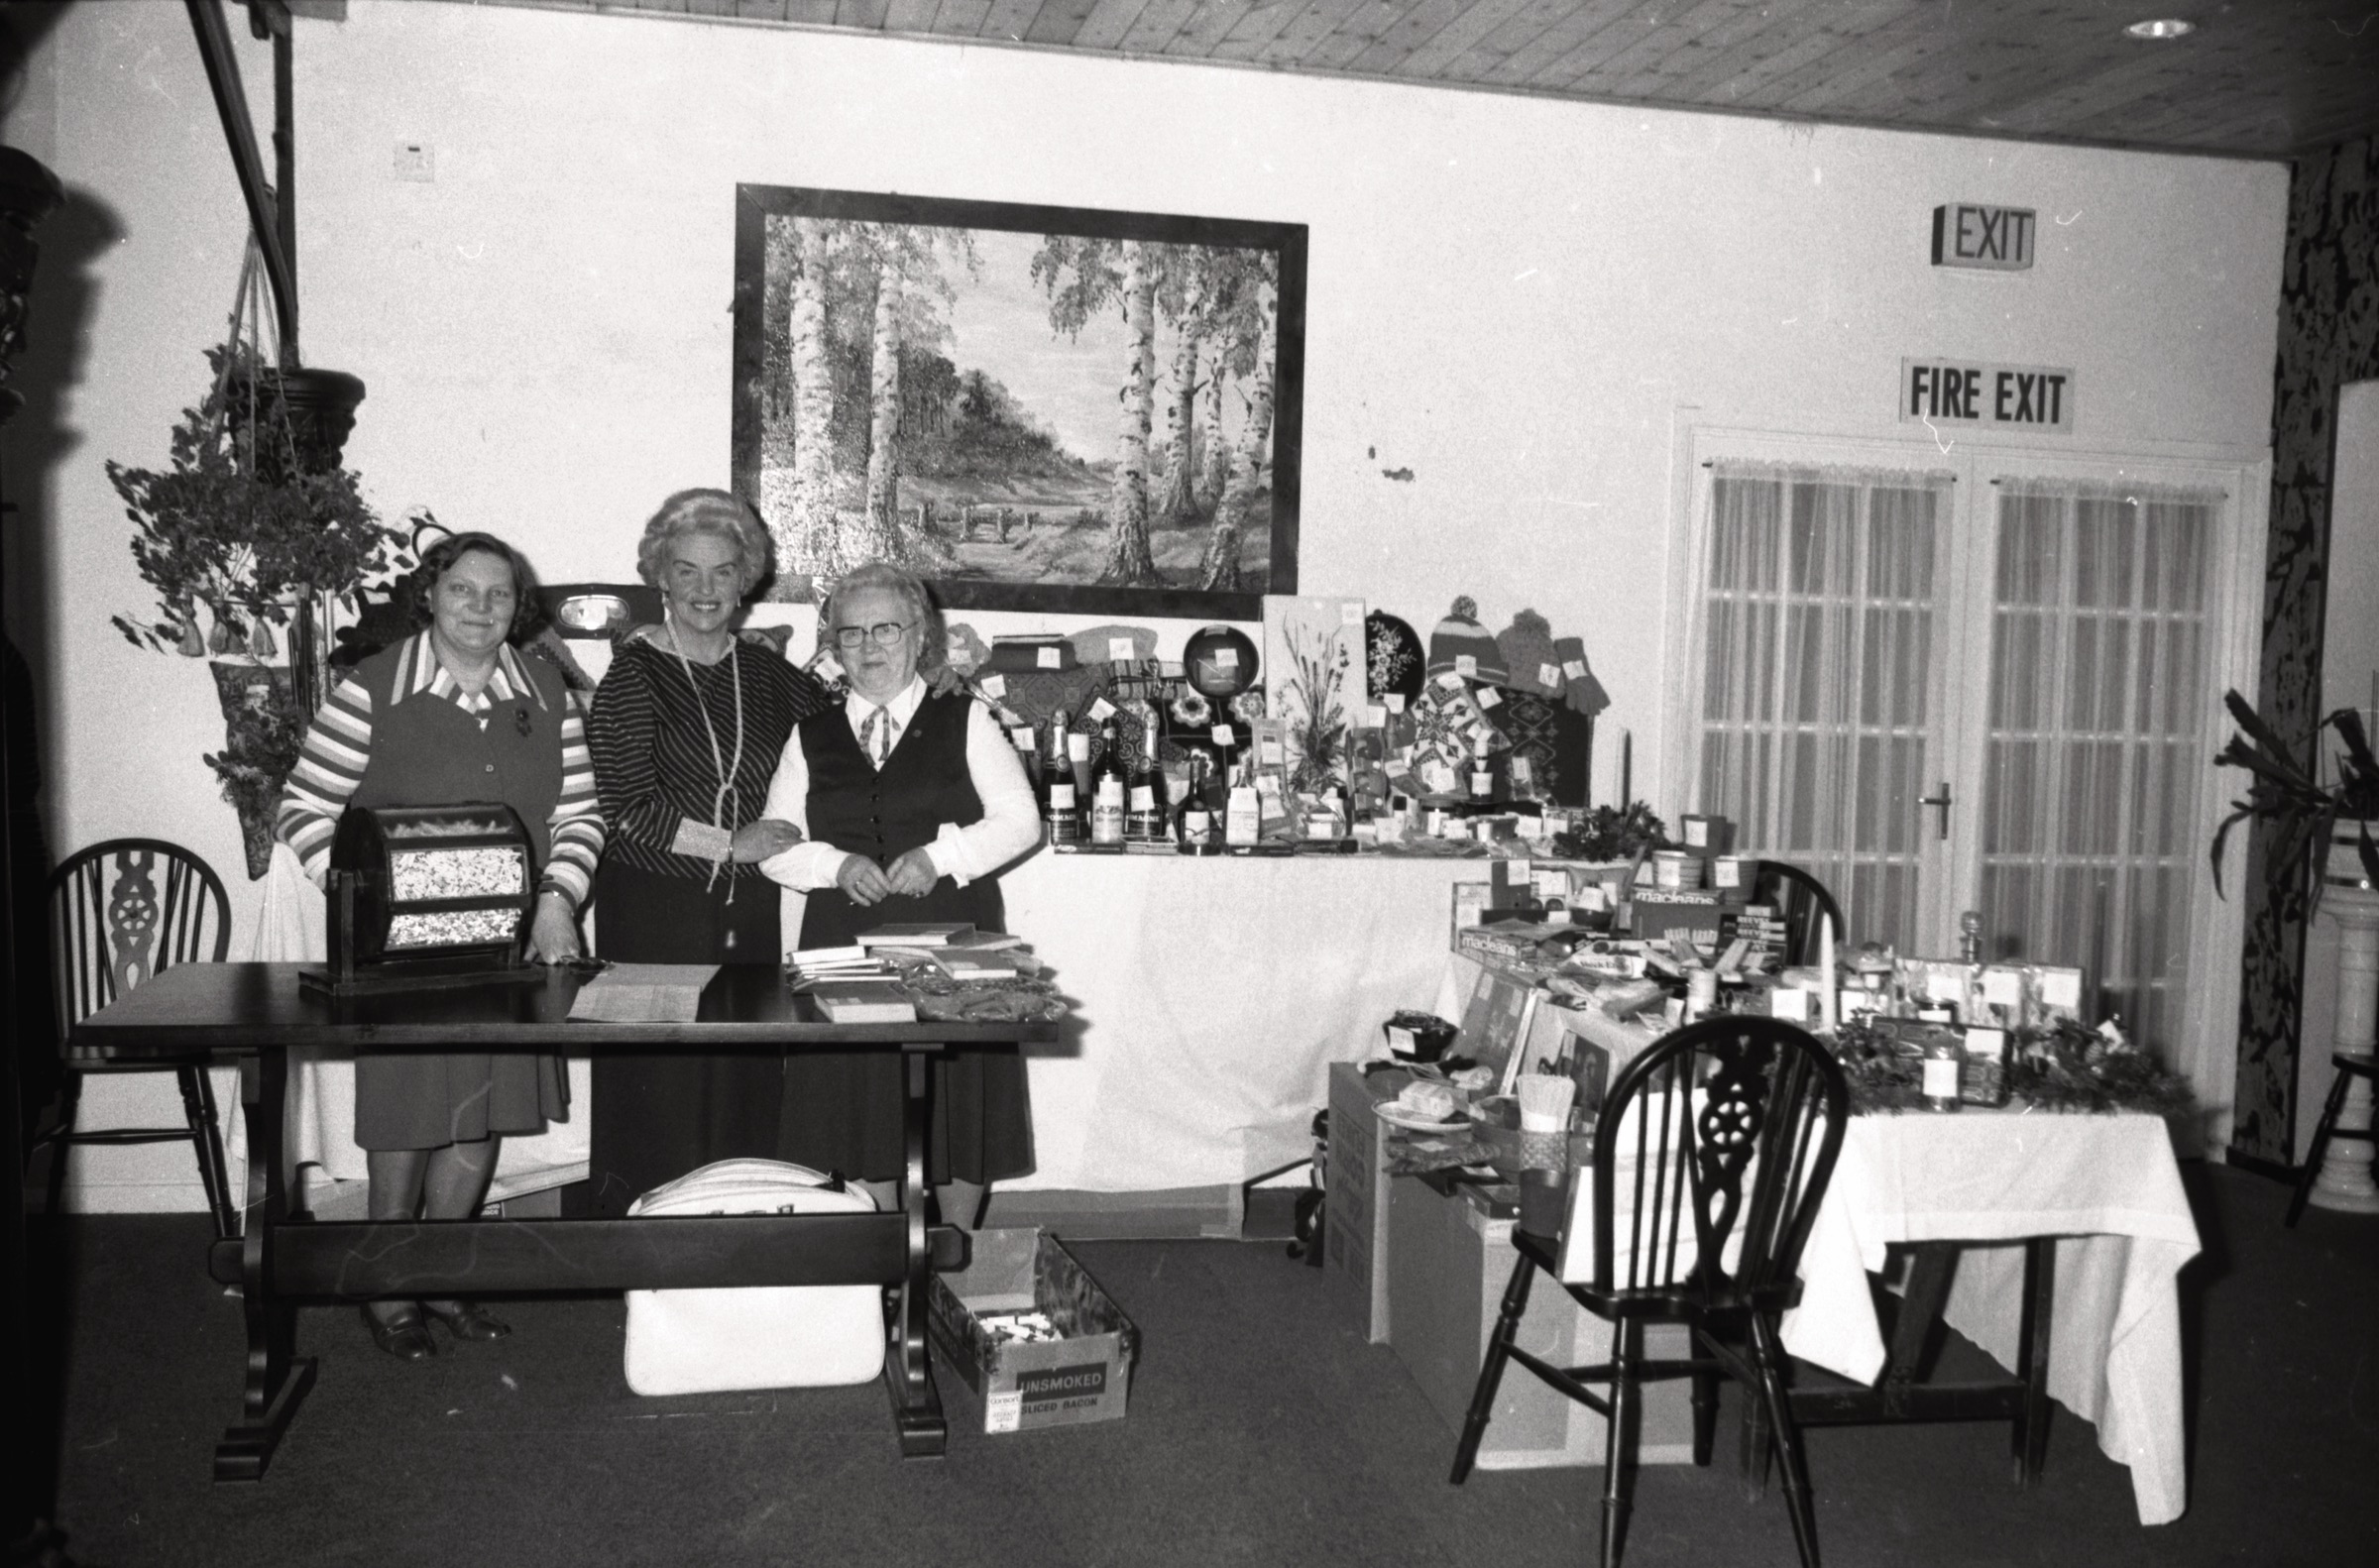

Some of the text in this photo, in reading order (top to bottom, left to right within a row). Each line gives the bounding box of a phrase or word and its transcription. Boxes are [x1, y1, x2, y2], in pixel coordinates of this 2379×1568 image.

[1956, 206, 2033, 261] EXIT
[1911, 366, 2066, 424] FIRE EXIT
[1635, 889, 1715, 905] macleans
[1462, 935, 1517, 956] macleans
[1020, 1373, 1102, 1394] UNSMOKED
[1021, 1398, 1097, 1414] SLICED BACON
